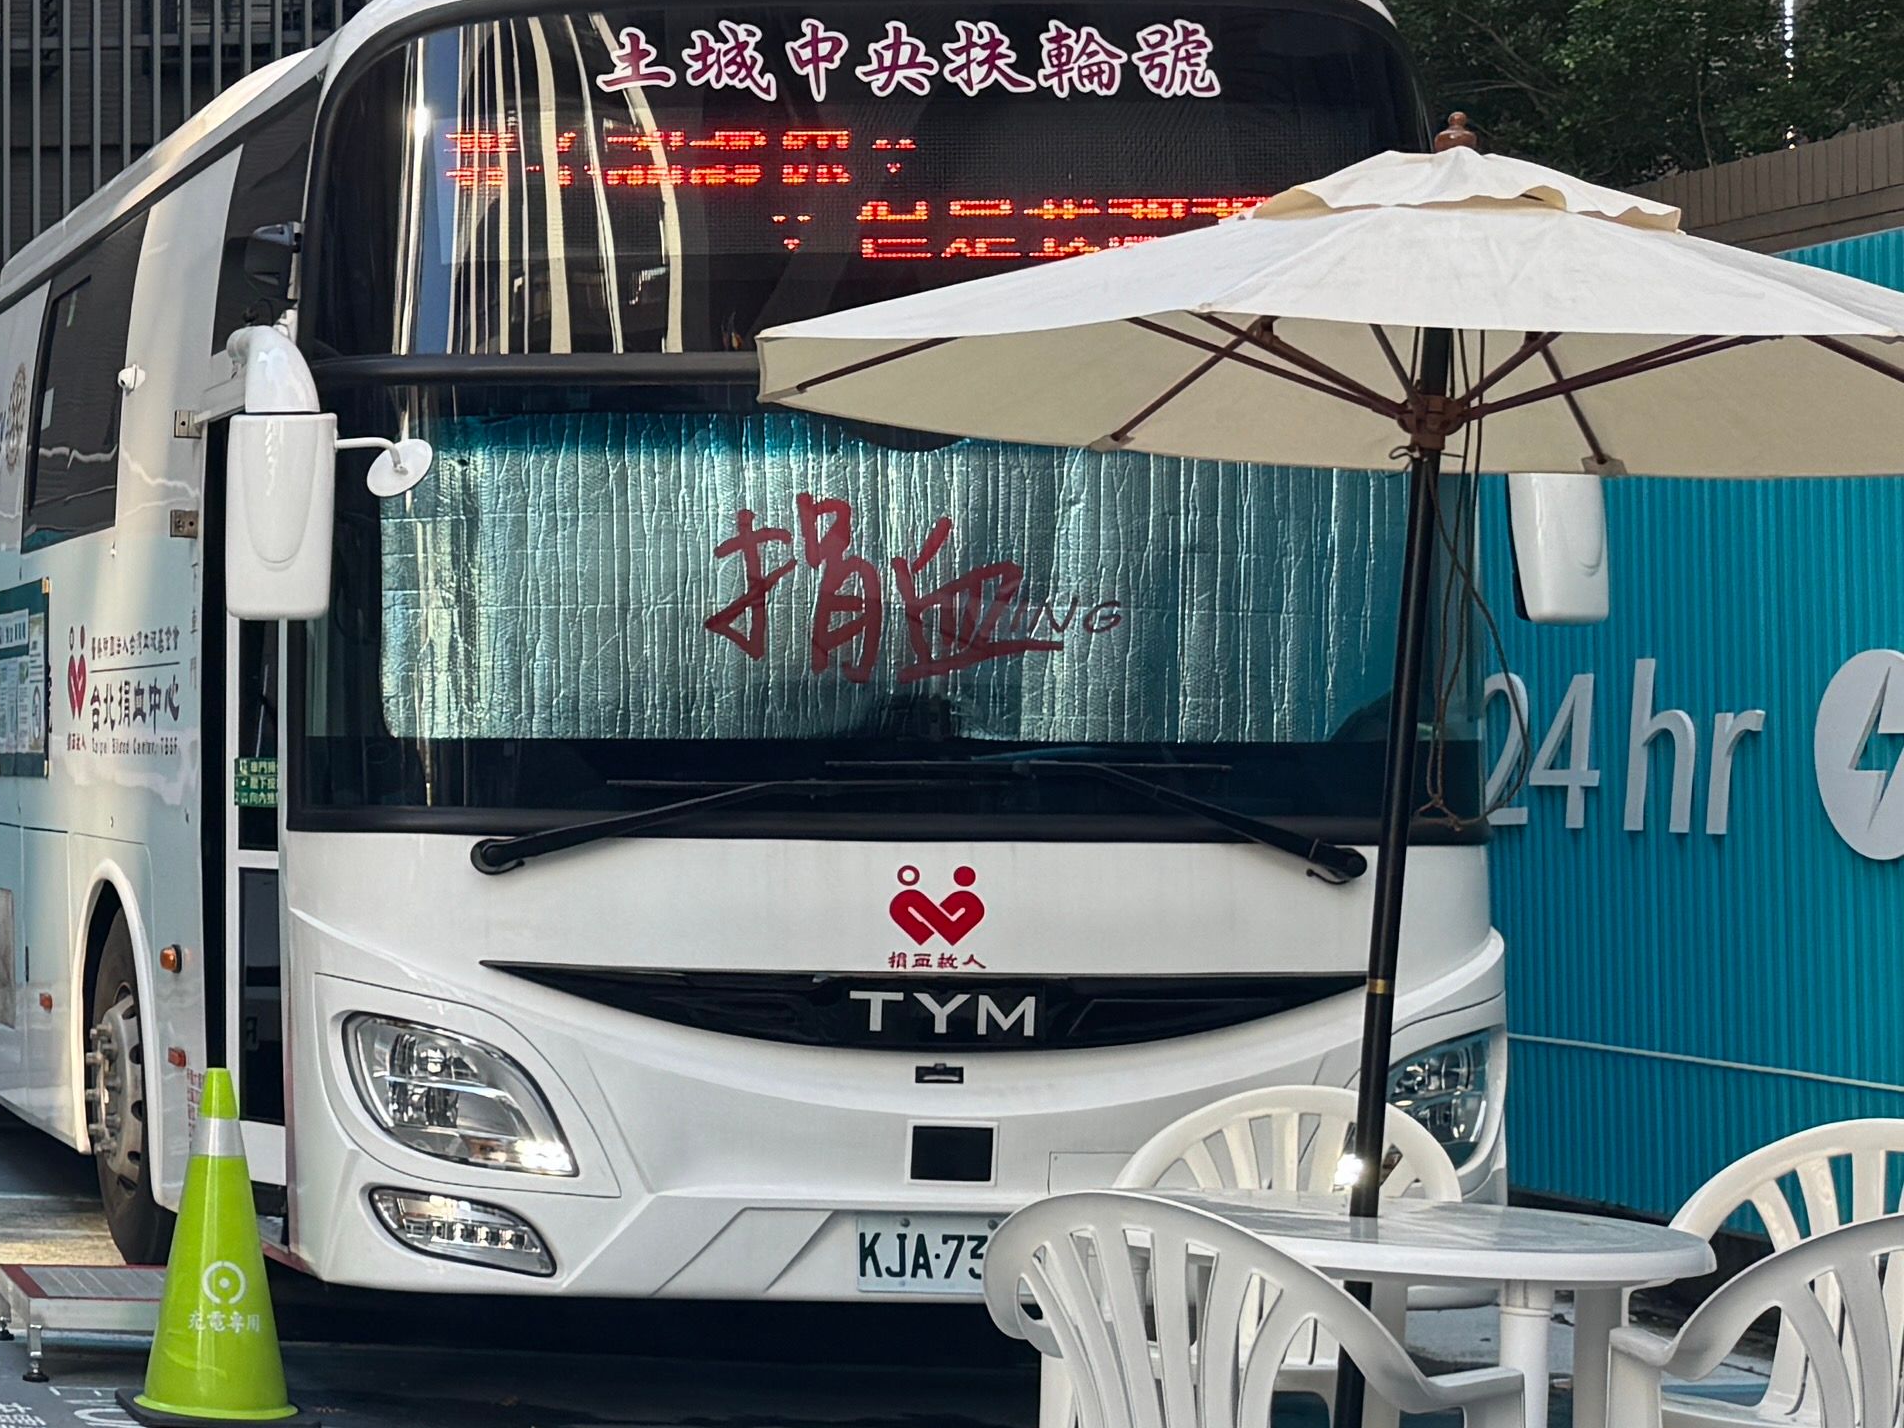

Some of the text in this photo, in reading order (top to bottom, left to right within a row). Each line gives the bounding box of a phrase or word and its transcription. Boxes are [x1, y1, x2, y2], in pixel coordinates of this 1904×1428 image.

[596, 17, 1221, 103] 土城中央扶輪號
[90, 674, 180, 734] 台北捐血中心
[850, 990, 1036, 1037] TYM
[188, 1310, 261, 1334] 充電專用
